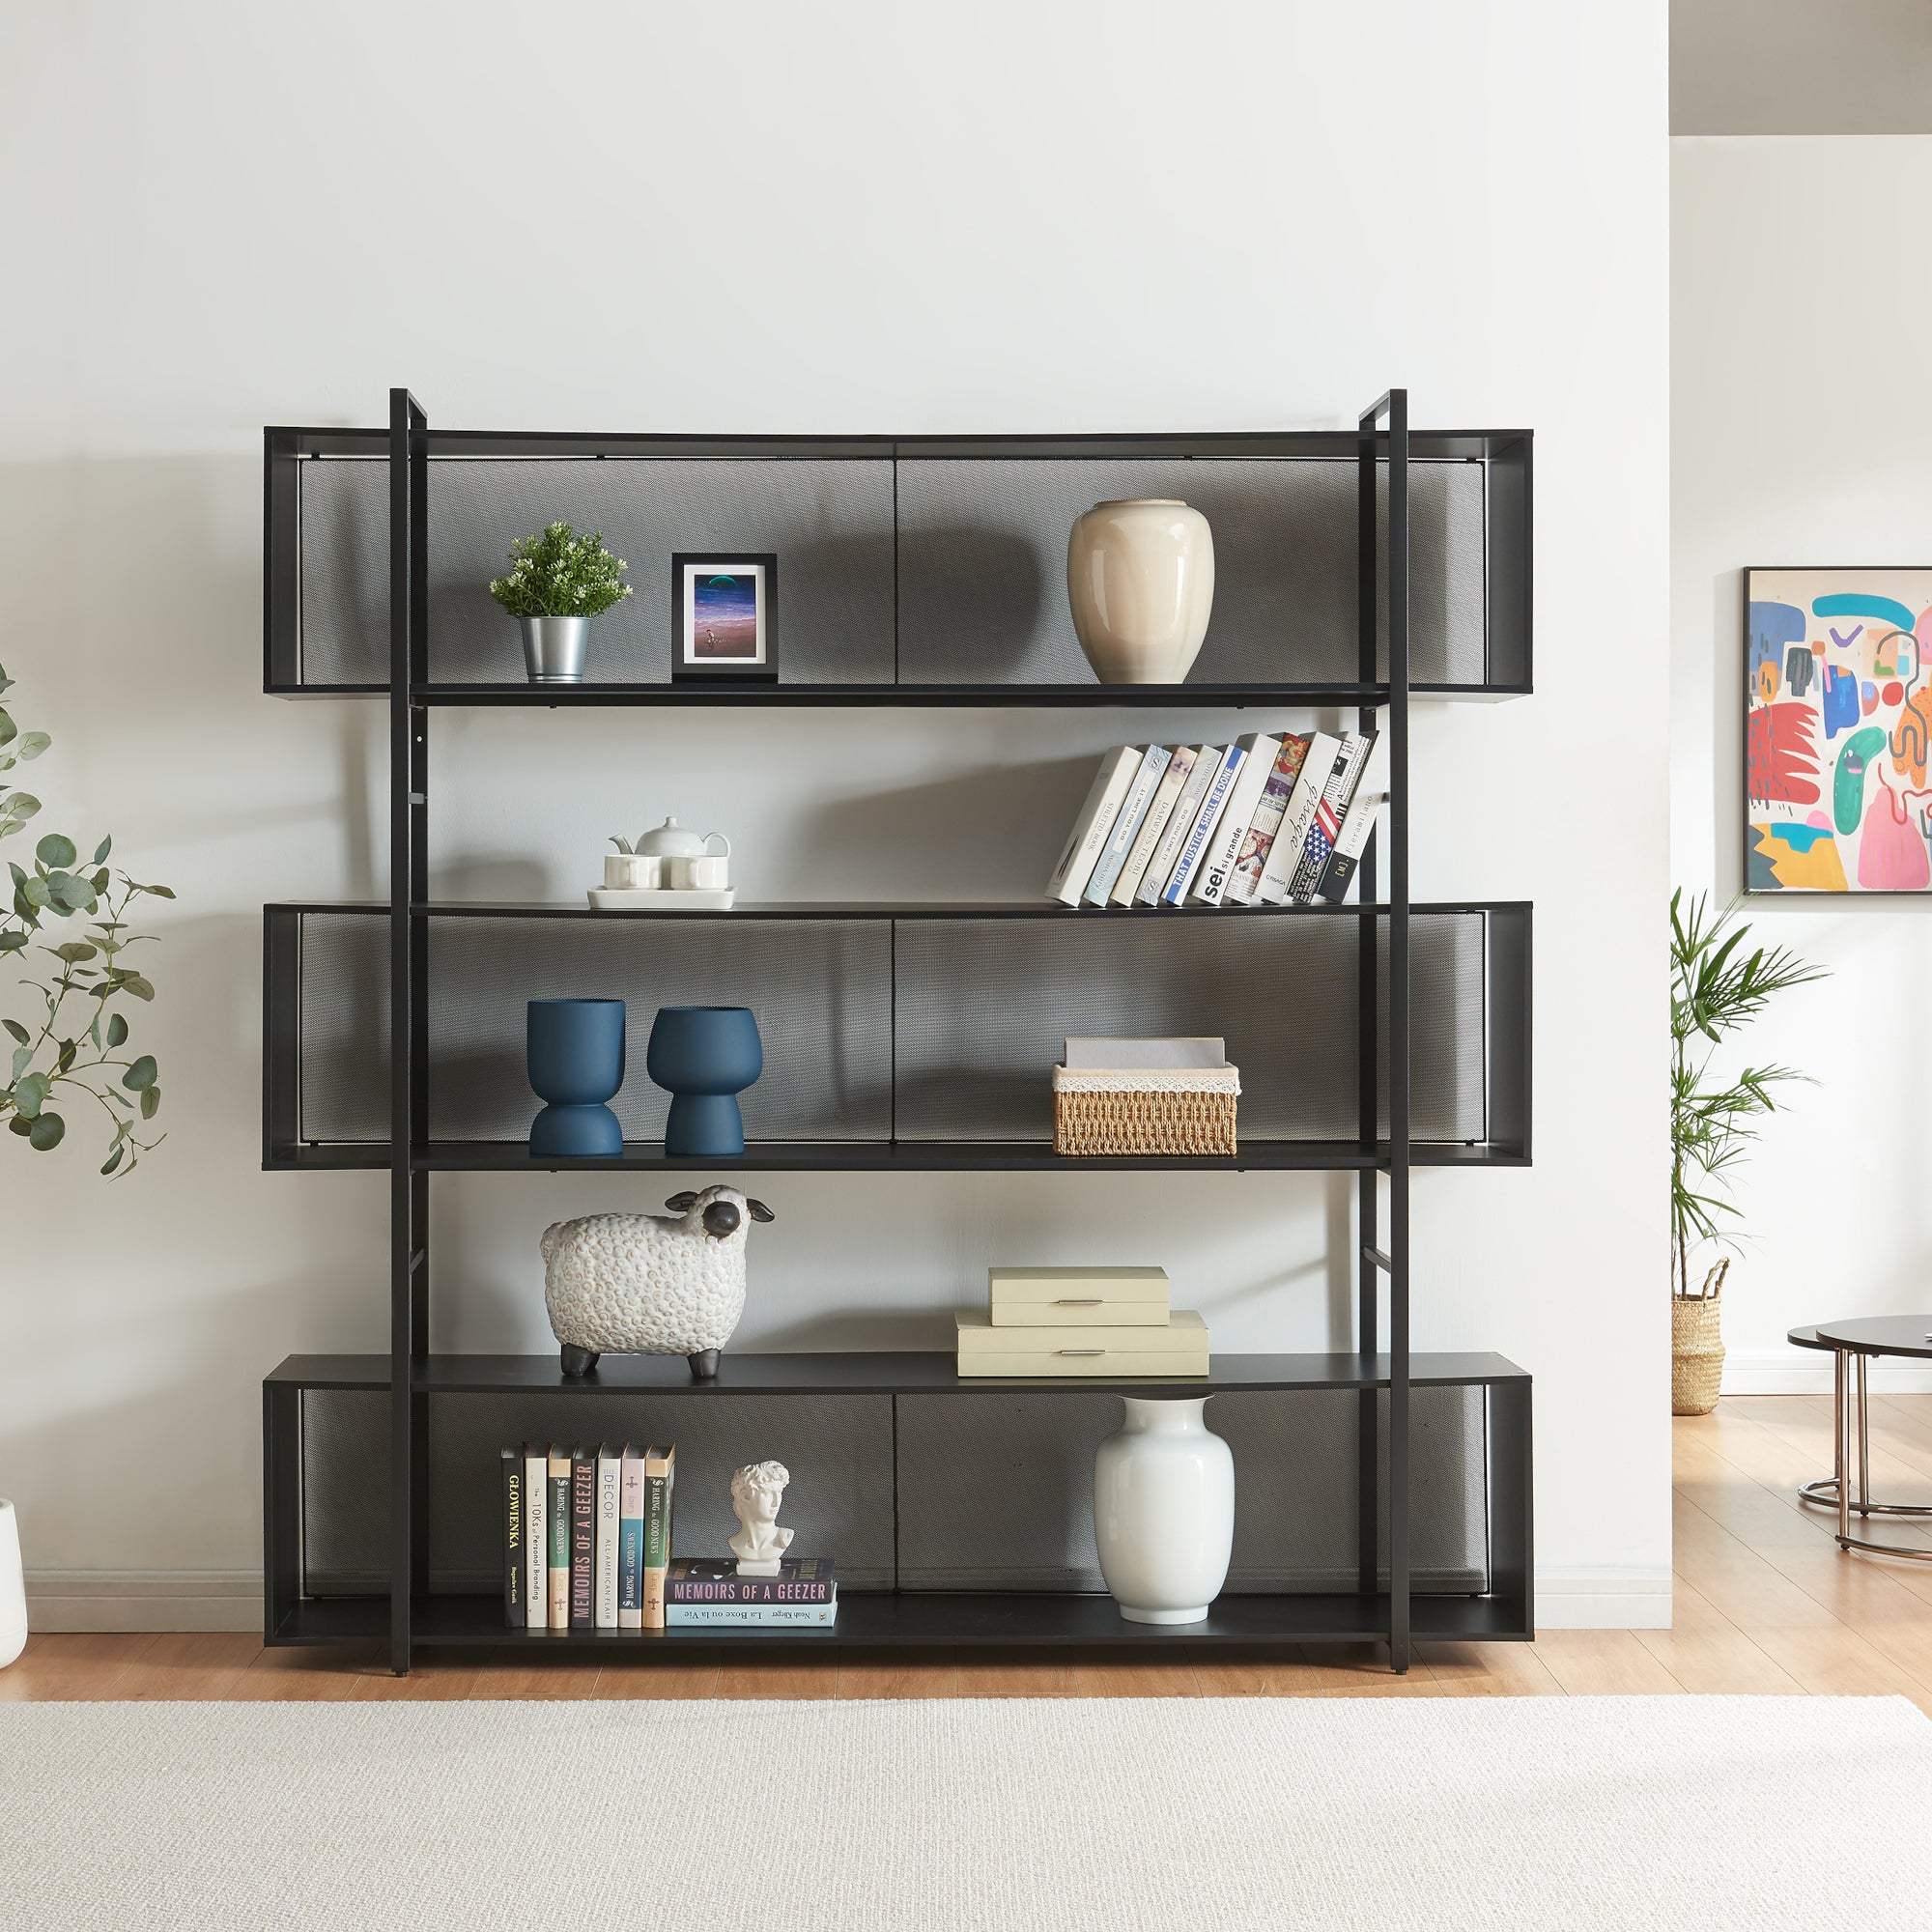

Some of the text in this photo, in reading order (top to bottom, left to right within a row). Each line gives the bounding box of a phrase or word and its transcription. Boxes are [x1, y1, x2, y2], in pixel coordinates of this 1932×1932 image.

[1120, 829, 1127, 840] DO
[1124, 812, 1134, 828] YOU
[1131, 796, 1142, 812] LIKE
[1146, 801, 1168, 845] DARWINS
[1172, 765, 1233, 886] THAT JUSTICE SHALL BE DONE
[1173, 821, 1182, 836] YOU
[1180, 809, 1188, 820] DO
[1345, 795, 1373, 853] Fieramilano
[1087, 832, 1099, 850] BOOK
[1165, 836, 1176, 852] LIKE
[1130, 845, 1149, 875] TEORI
[1205, 827, 1242, 899] sei si grande
[555, 1478, 568, 1511] SHARING
[576, 1465, 591, 1514] GEEZER
[604, 1474, 614, 1519] DECOR
[650, 1478, 664, 1511] SHARING
[509, 1474, 520, 1548] GŁOWIENKA
[532, 1503, 541, 1526] 10Ks
[577, 1534, 590, 1549] OF
[574, 1556, 590, 1617] MEMOIRS
[623, 1576, 636, 1607] SHARING
[674, 1584, 825, 1600] MEMOIRS OF A GEEZER
